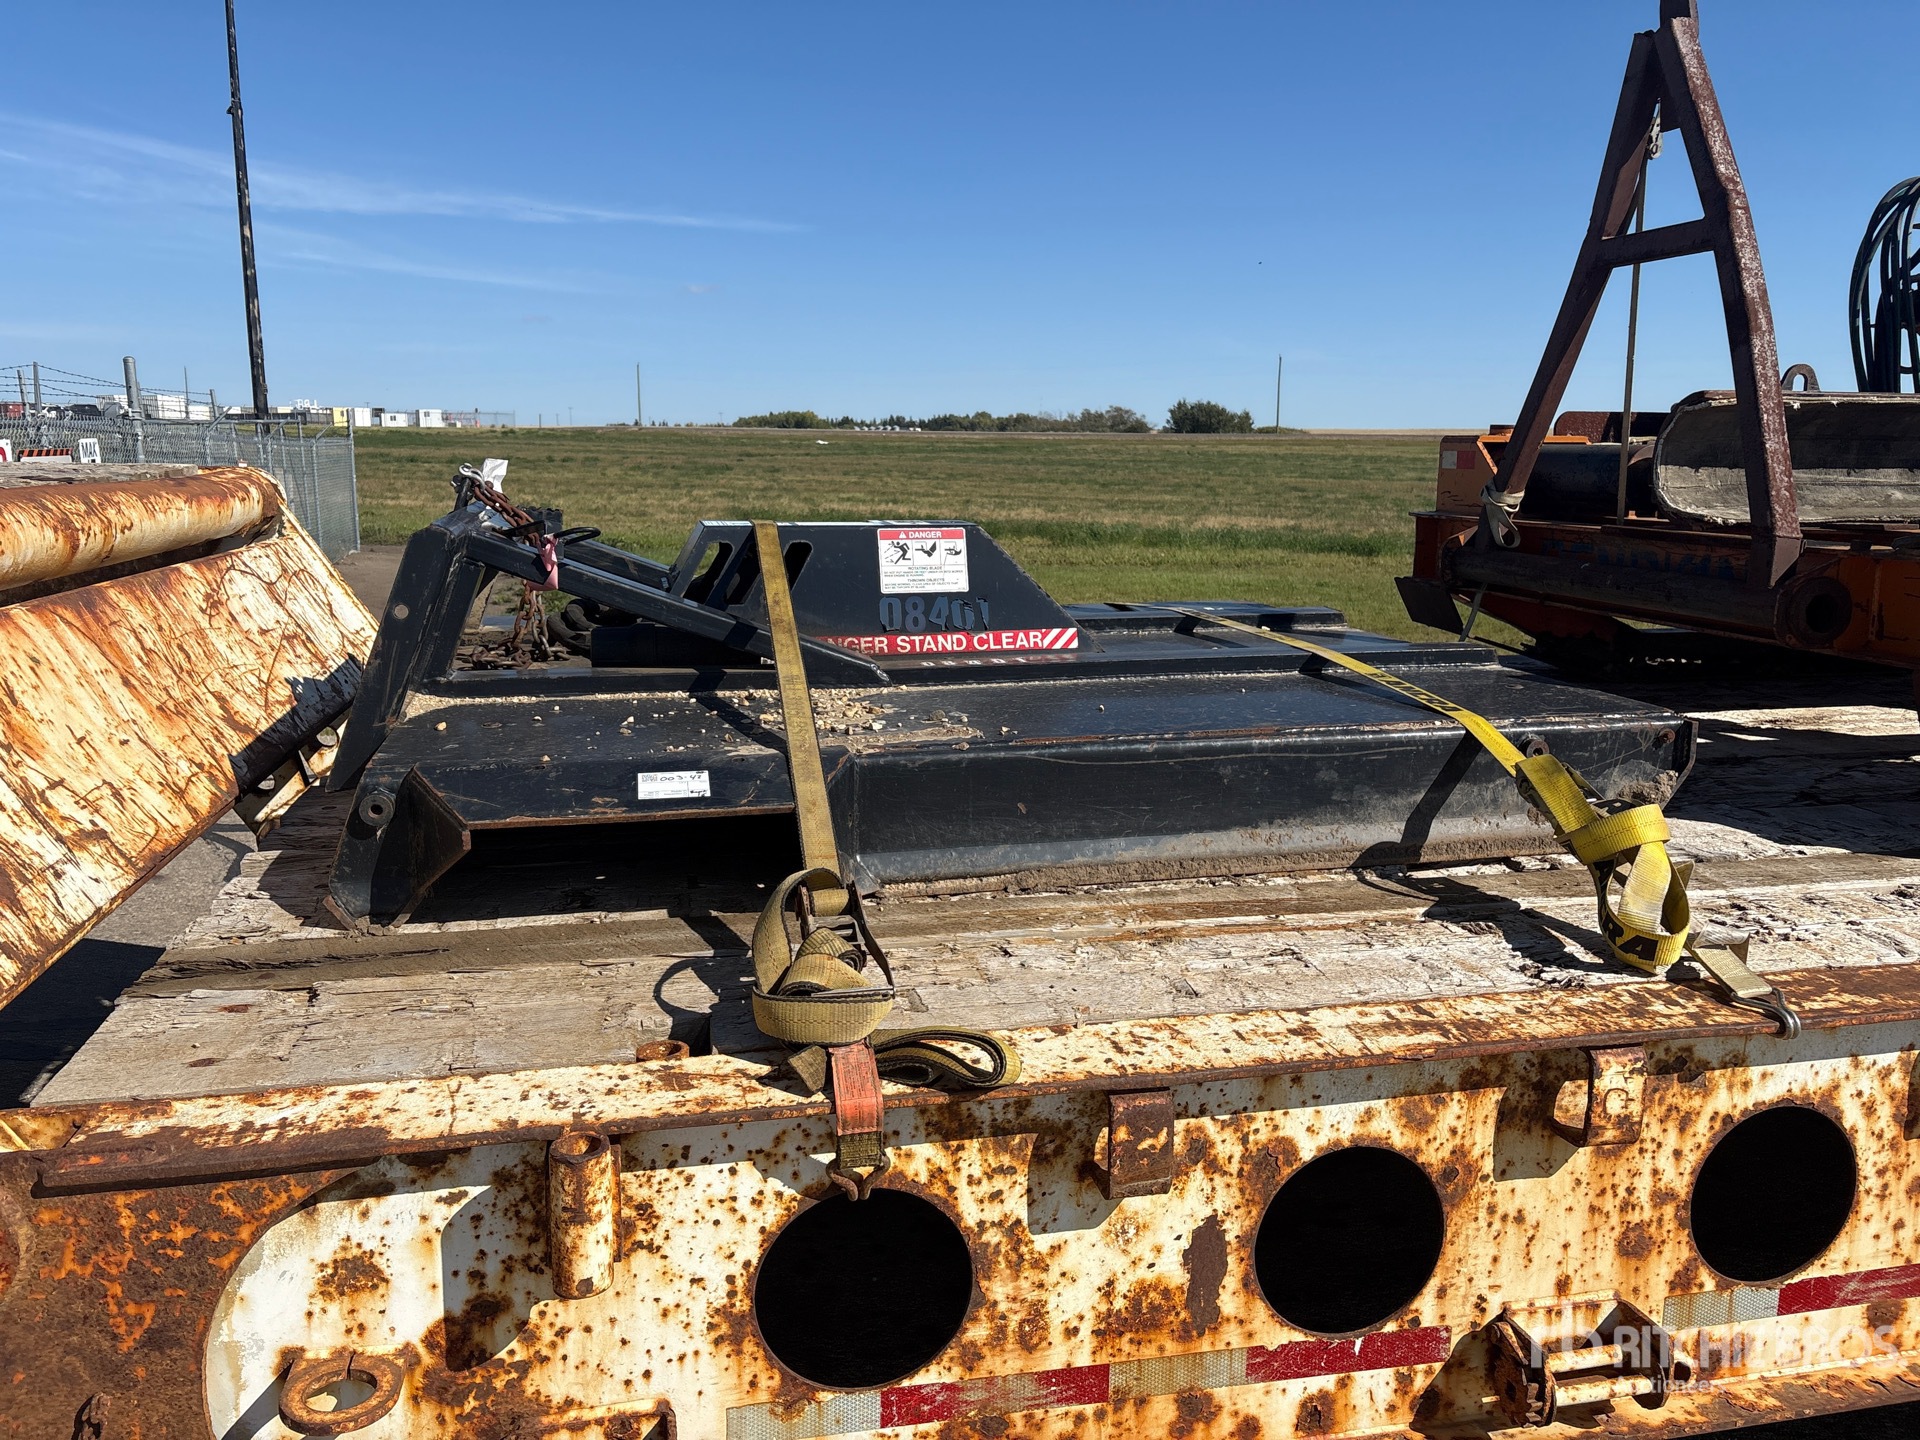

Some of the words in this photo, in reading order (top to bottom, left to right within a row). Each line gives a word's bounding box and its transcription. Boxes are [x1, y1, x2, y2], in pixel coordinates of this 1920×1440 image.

[827, 637, 889, 654] NGER
[896, 634, 967, 653] STAND
[973, 632, 1043, 650] CLEAR
